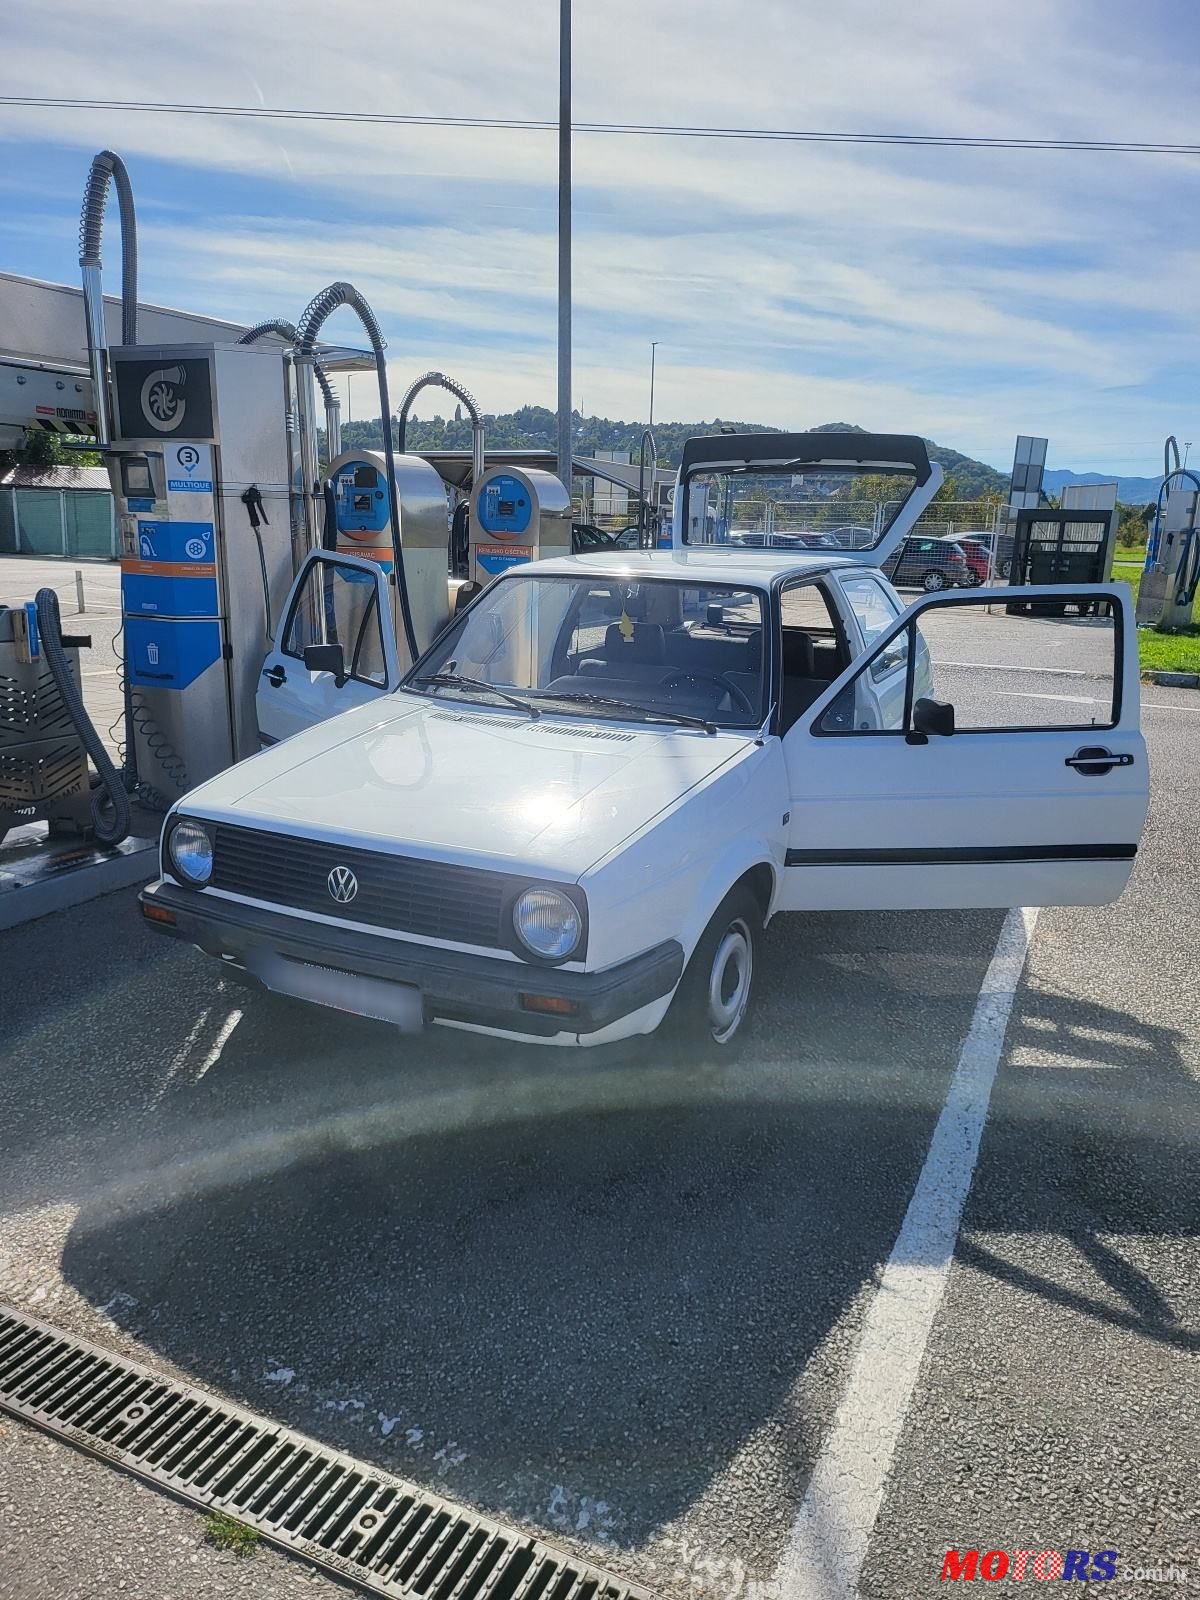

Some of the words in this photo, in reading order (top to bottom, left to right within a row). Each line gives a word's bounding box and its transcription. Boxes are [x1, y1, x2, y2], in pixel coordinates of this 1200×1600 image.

[185, 451, 193, 462] 3
[170, 481, 211, 489] MULTIQUE
[328, 866, 357, 903] VW
